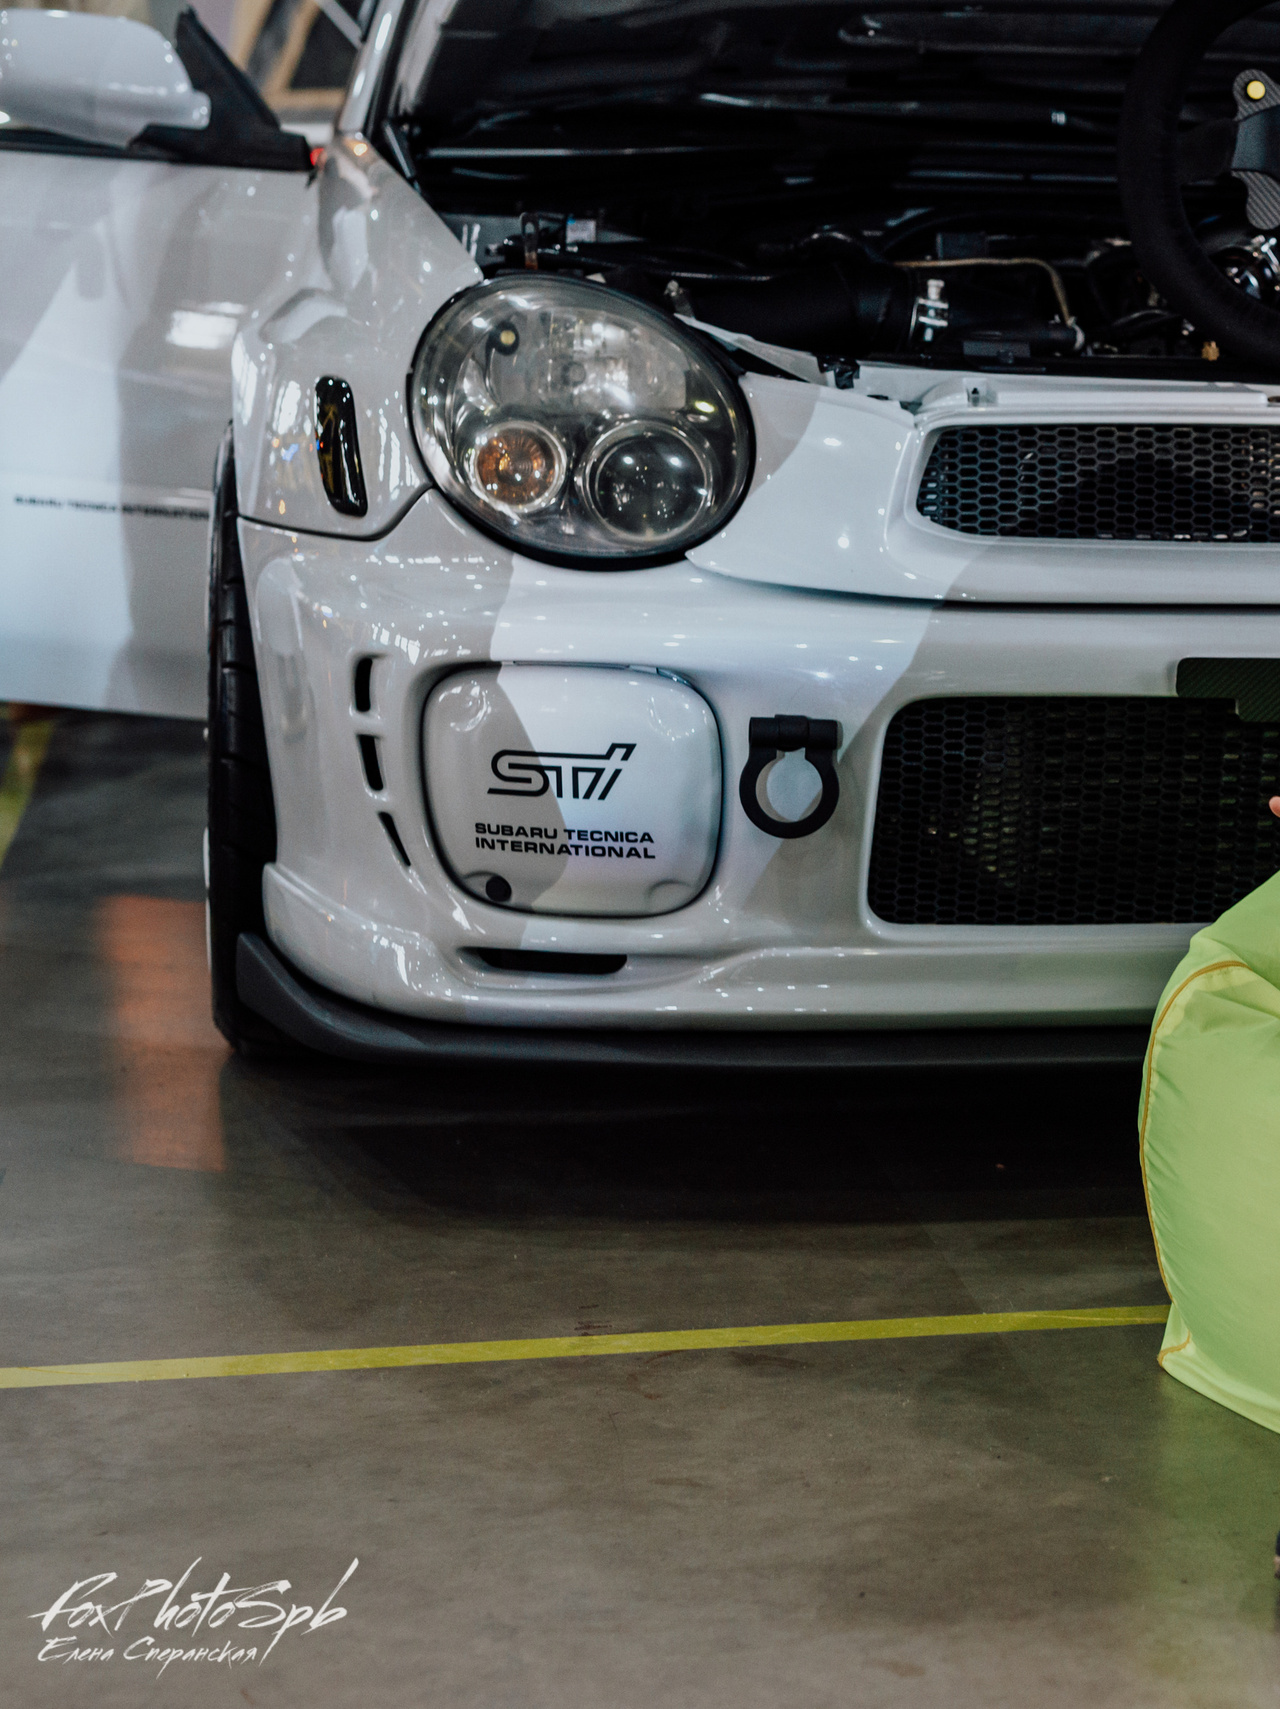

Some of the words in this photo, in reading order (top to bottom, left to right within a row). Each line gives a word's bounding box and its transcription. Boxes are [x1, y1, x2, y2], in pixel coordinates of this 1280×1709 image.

[475, 823, 558, 839] SUBARU
[563, 829, 655, 844] TECNICA
[475, 837, 656, 860] INTERNATIONAL
